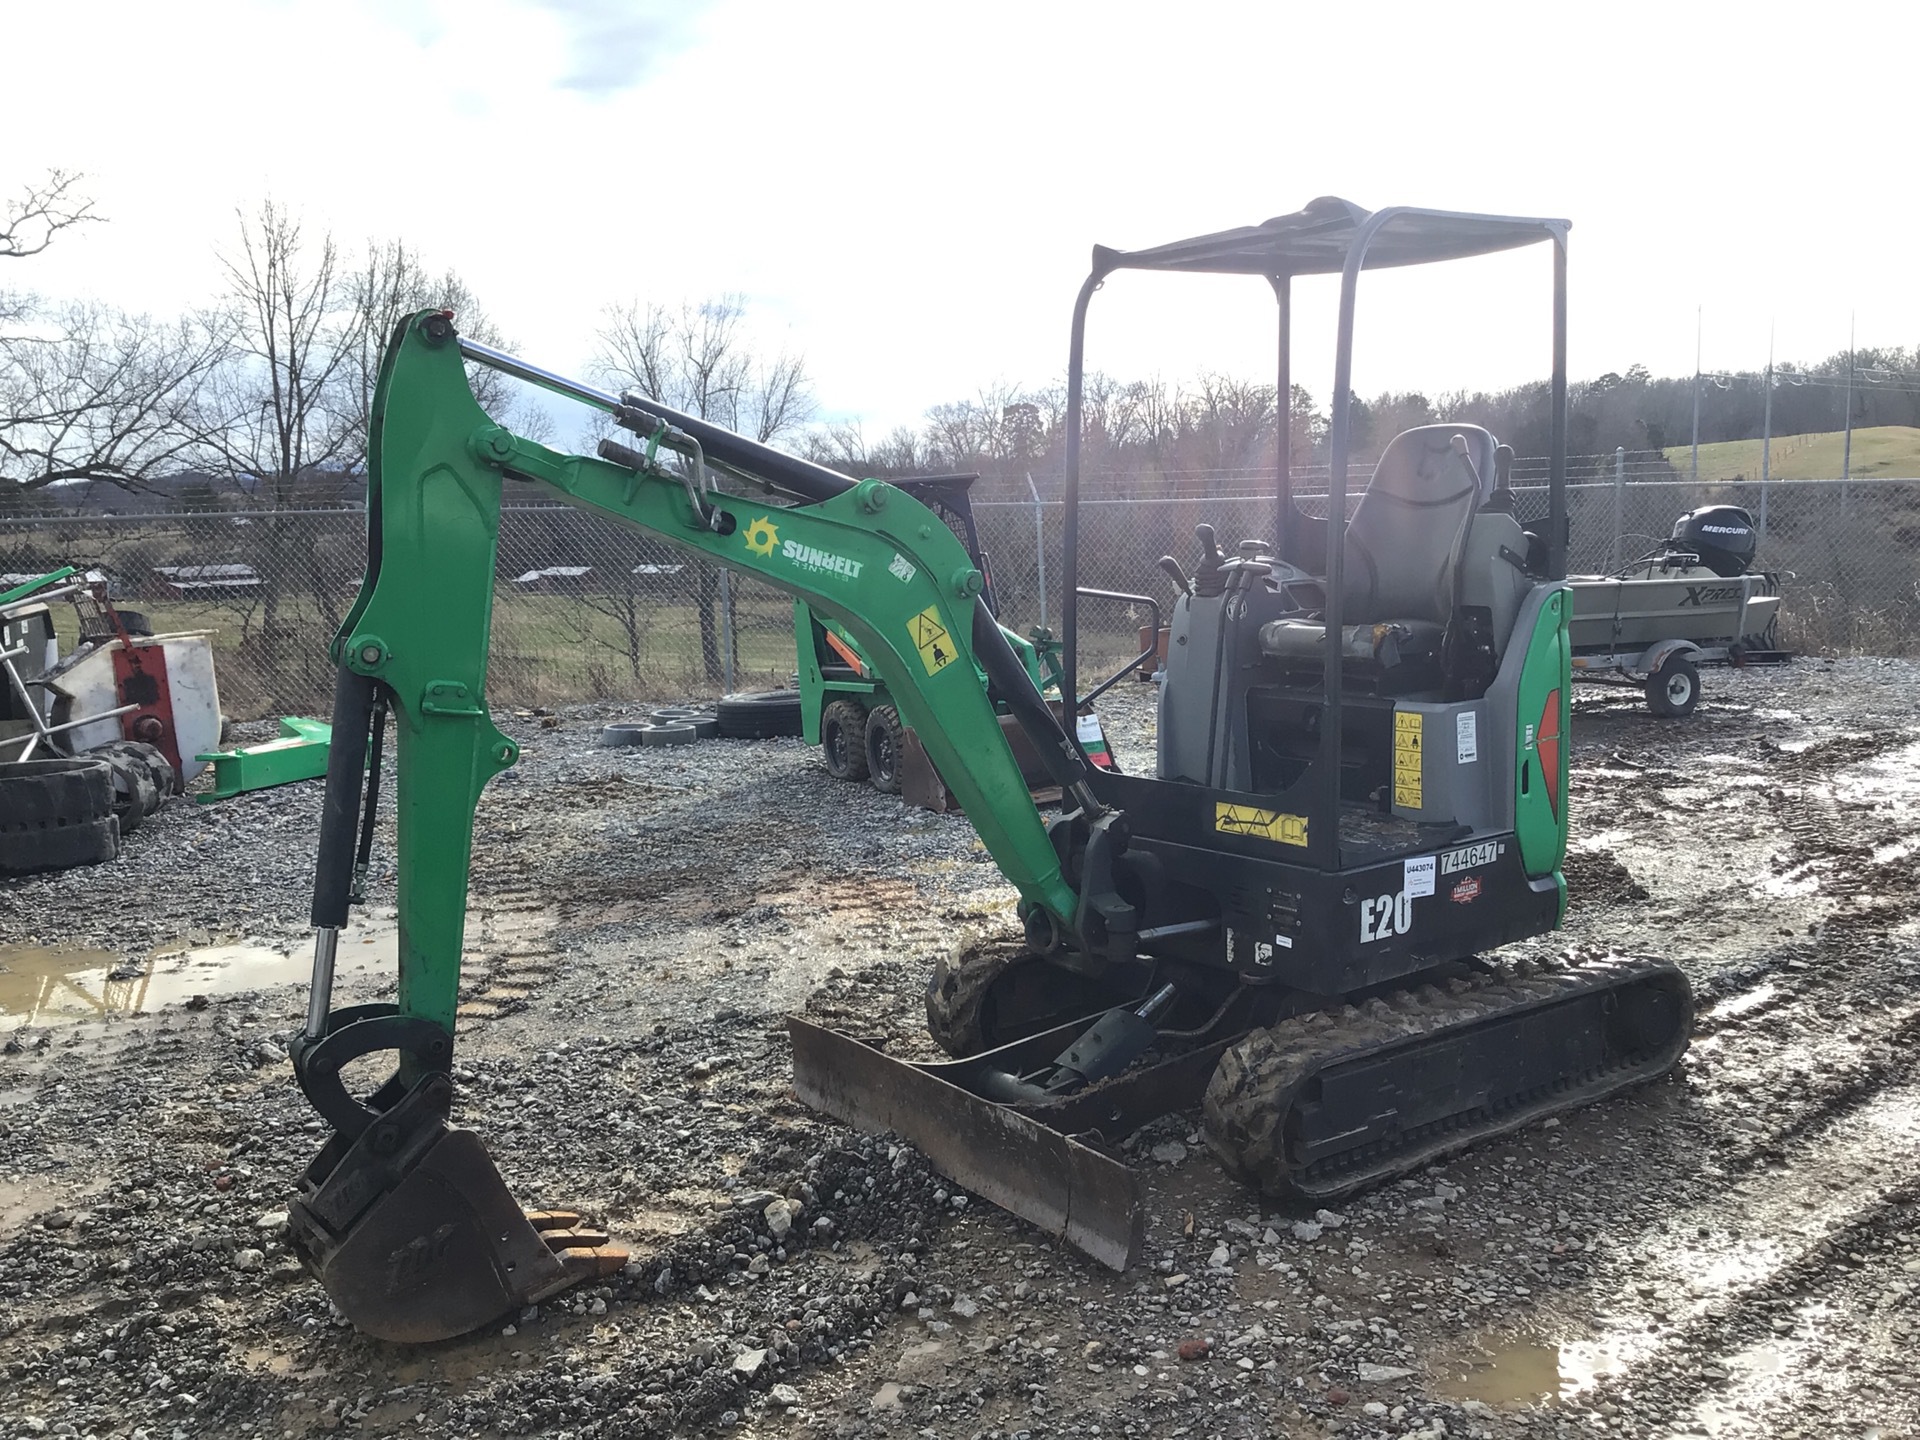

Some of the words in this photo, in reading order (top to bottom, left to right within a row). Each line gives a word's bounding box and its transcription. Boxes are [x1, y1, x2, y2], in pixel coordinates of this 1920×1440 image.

[1701, 524, 1749, 535] MERCURY
[781, 539, 864, 579] SUNBELT
[1406, 863, 1433, 874] U443074
[1442, 842, 1496, 873] 744647
[1360, 890, 1412, 944] E20
